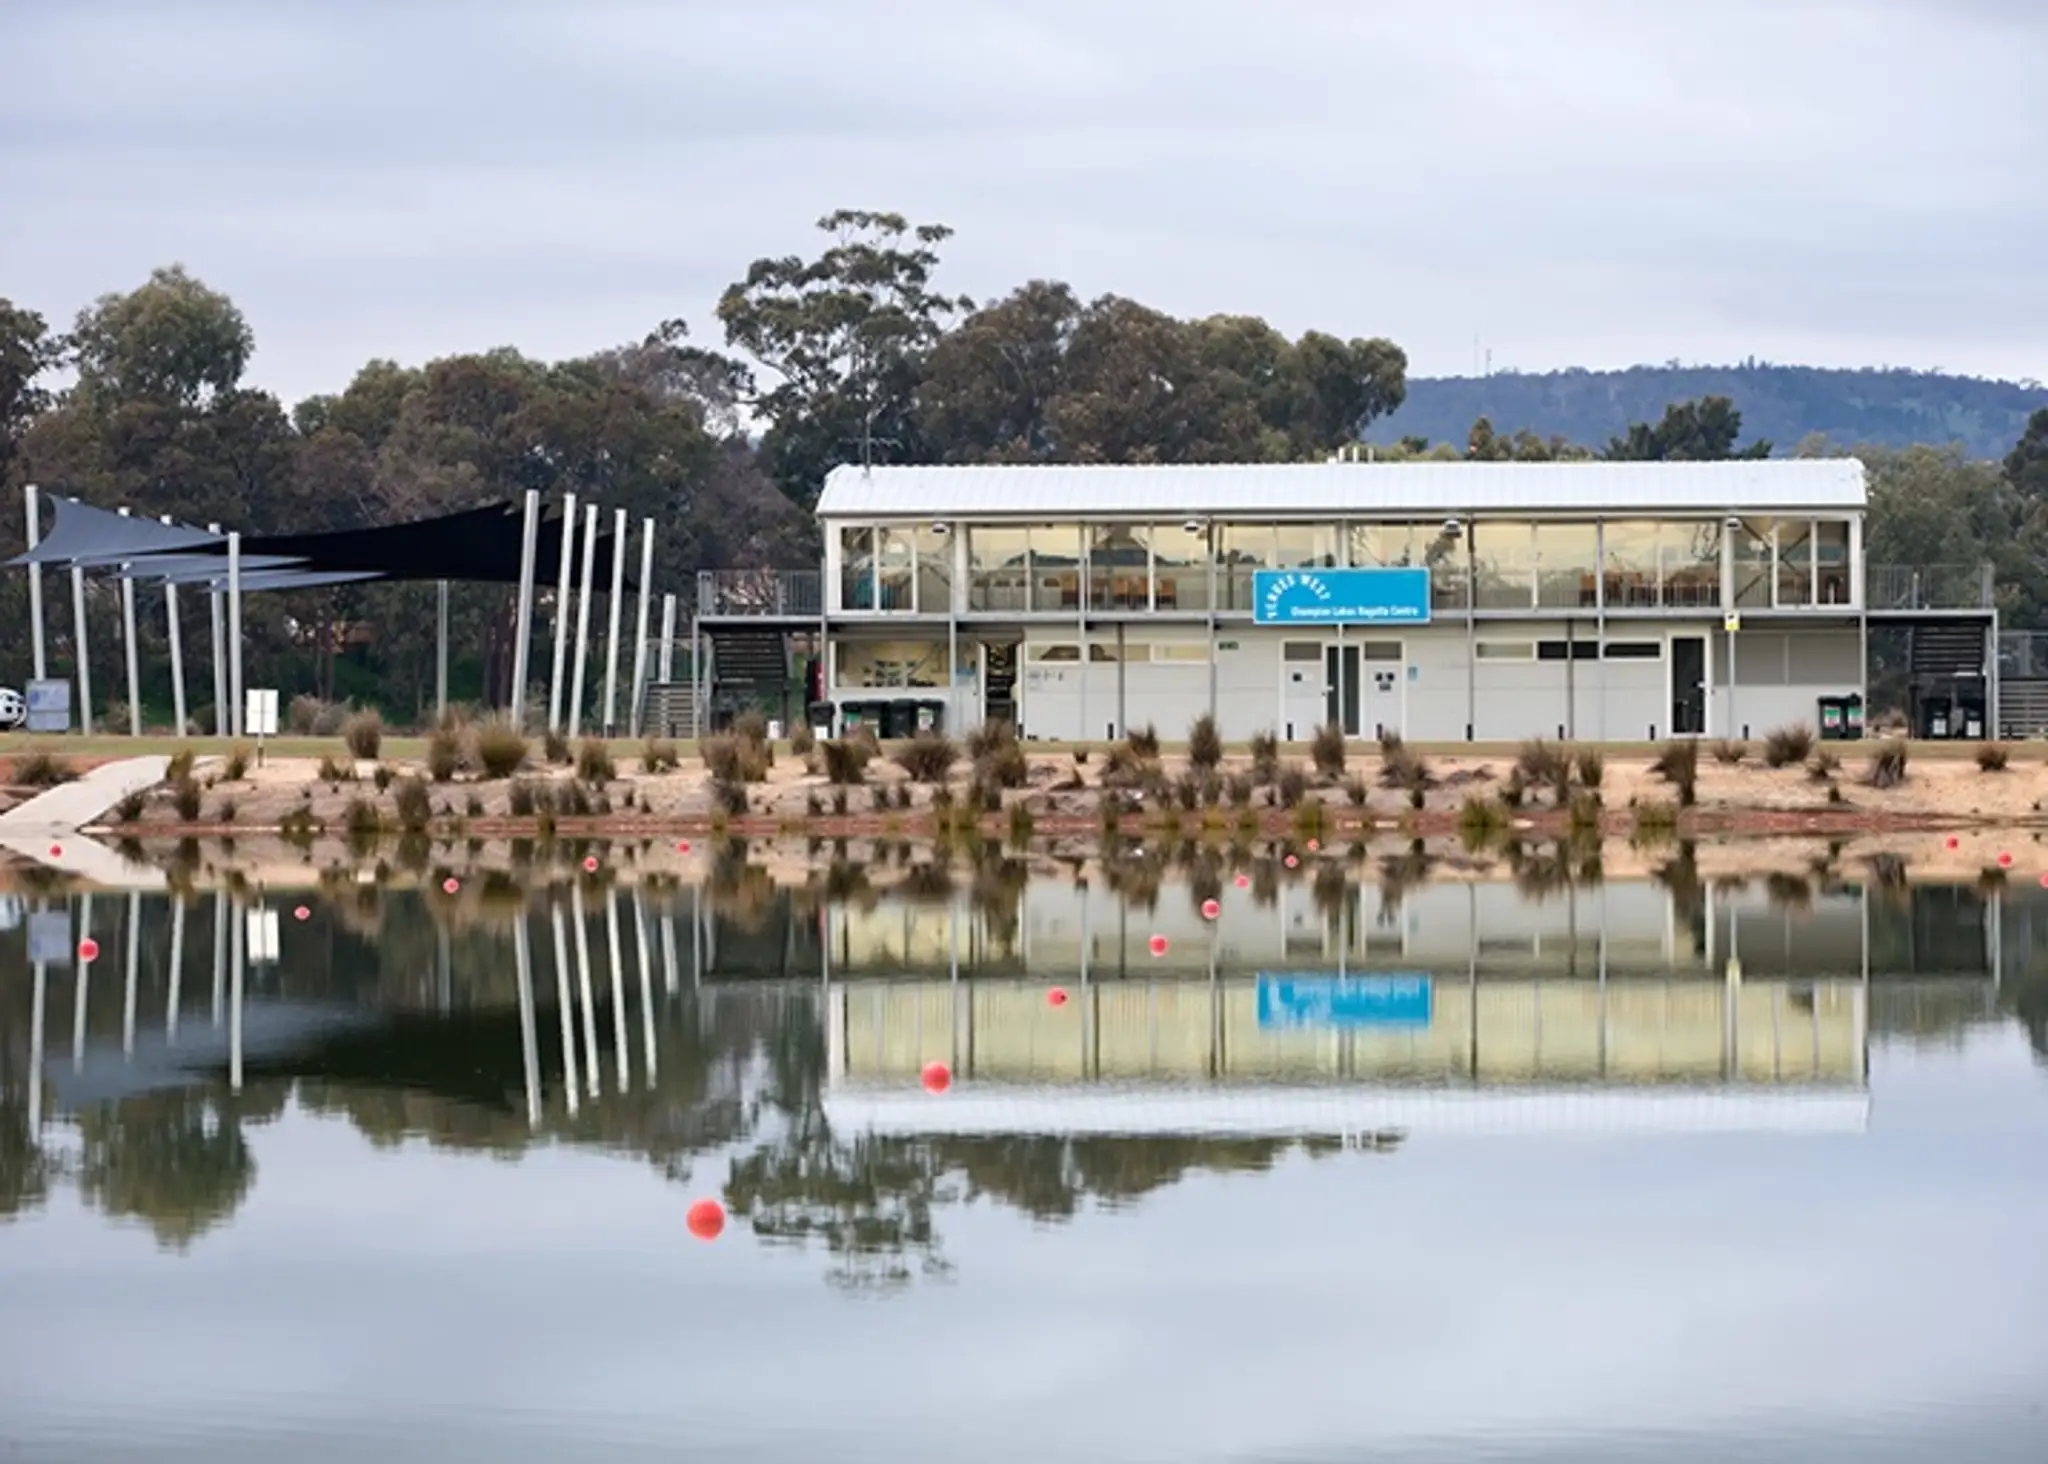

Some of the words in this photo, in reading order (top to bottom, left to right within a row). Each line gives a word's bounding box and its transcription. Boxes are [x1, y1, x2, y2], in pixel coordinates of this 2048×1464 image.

[1290, 606, 1331, 618] Champion
[1332, 606, 1357, 617] Lakes
[1358, 606, 1389, 619] Regatta
[1390, 604, 1419, 617] Centre
